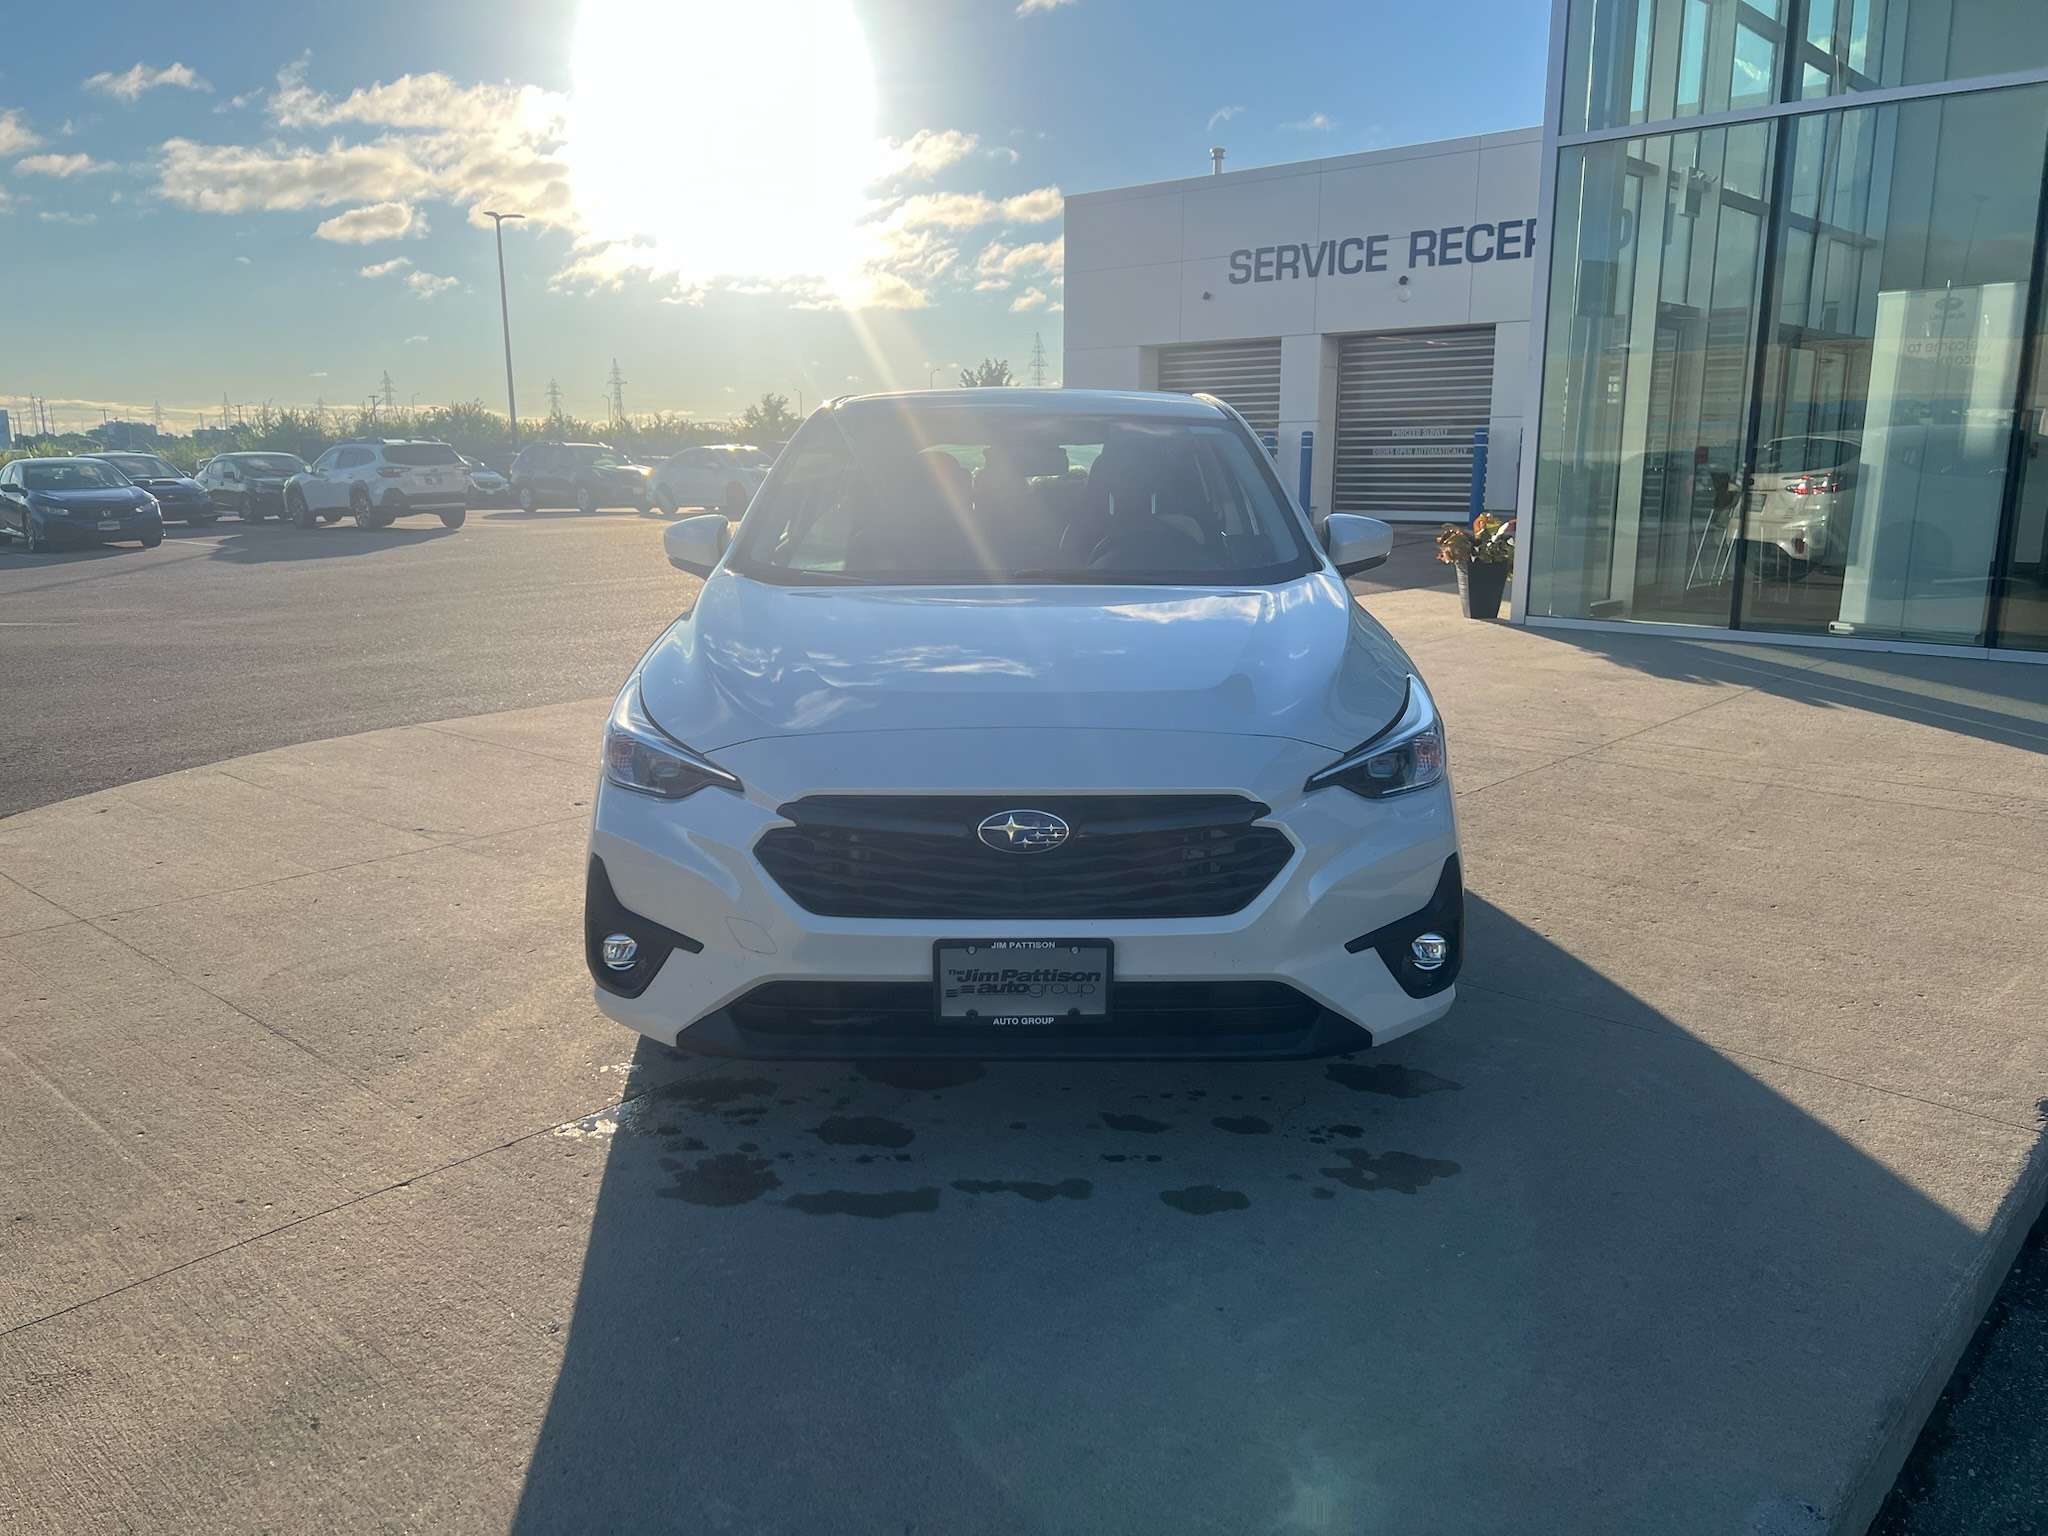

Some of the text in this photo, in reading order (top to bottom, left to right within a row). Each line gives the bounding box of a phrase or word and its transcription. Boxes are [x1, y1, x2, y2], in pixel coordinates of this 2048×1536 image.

[1228, 234, 1389, 285] SERVICE
[991, 941, 1056, 949] JIM PATTISON
[957, 968, 1000, 983] Jim
[1000, 968, 1102, 983] Pattison
[992, 1016, 1055, 1025] AUTO GROUP
